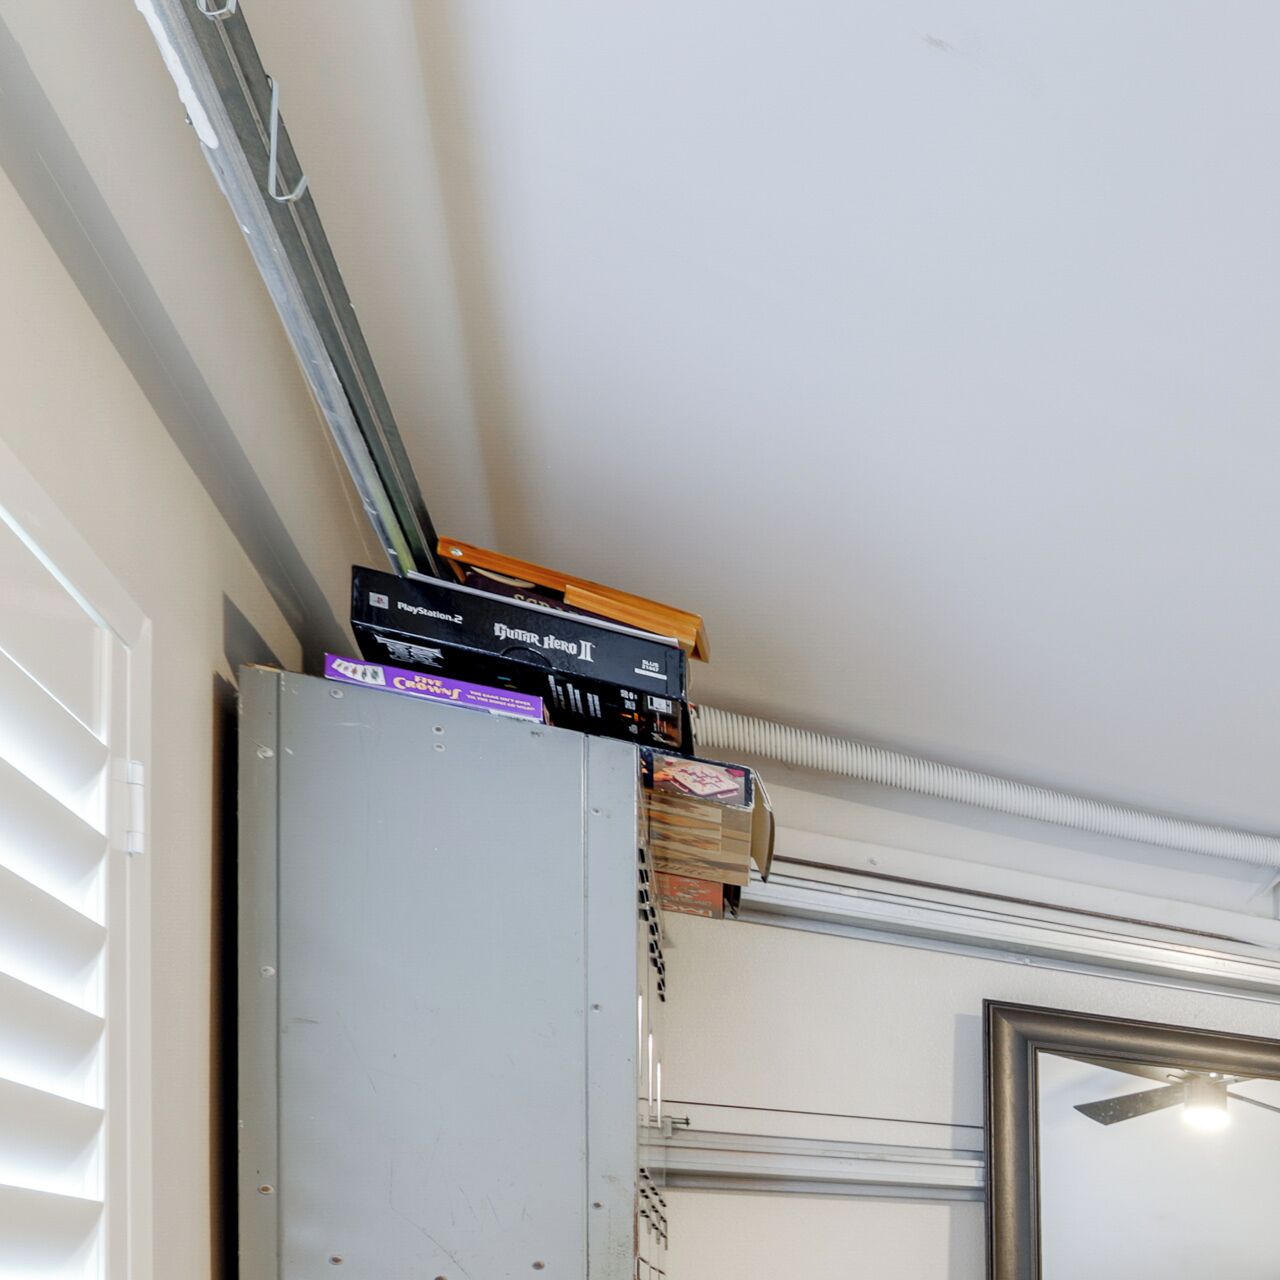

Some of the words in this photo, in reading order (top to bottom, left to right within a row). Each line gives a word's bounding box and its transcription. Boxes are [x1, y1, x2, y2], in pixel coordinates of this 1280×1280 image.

[397, 601, 453, 622] PlayStation
[393, 676, 462, 701] CROWNS
[413, 675, 444, 688] FIVE
